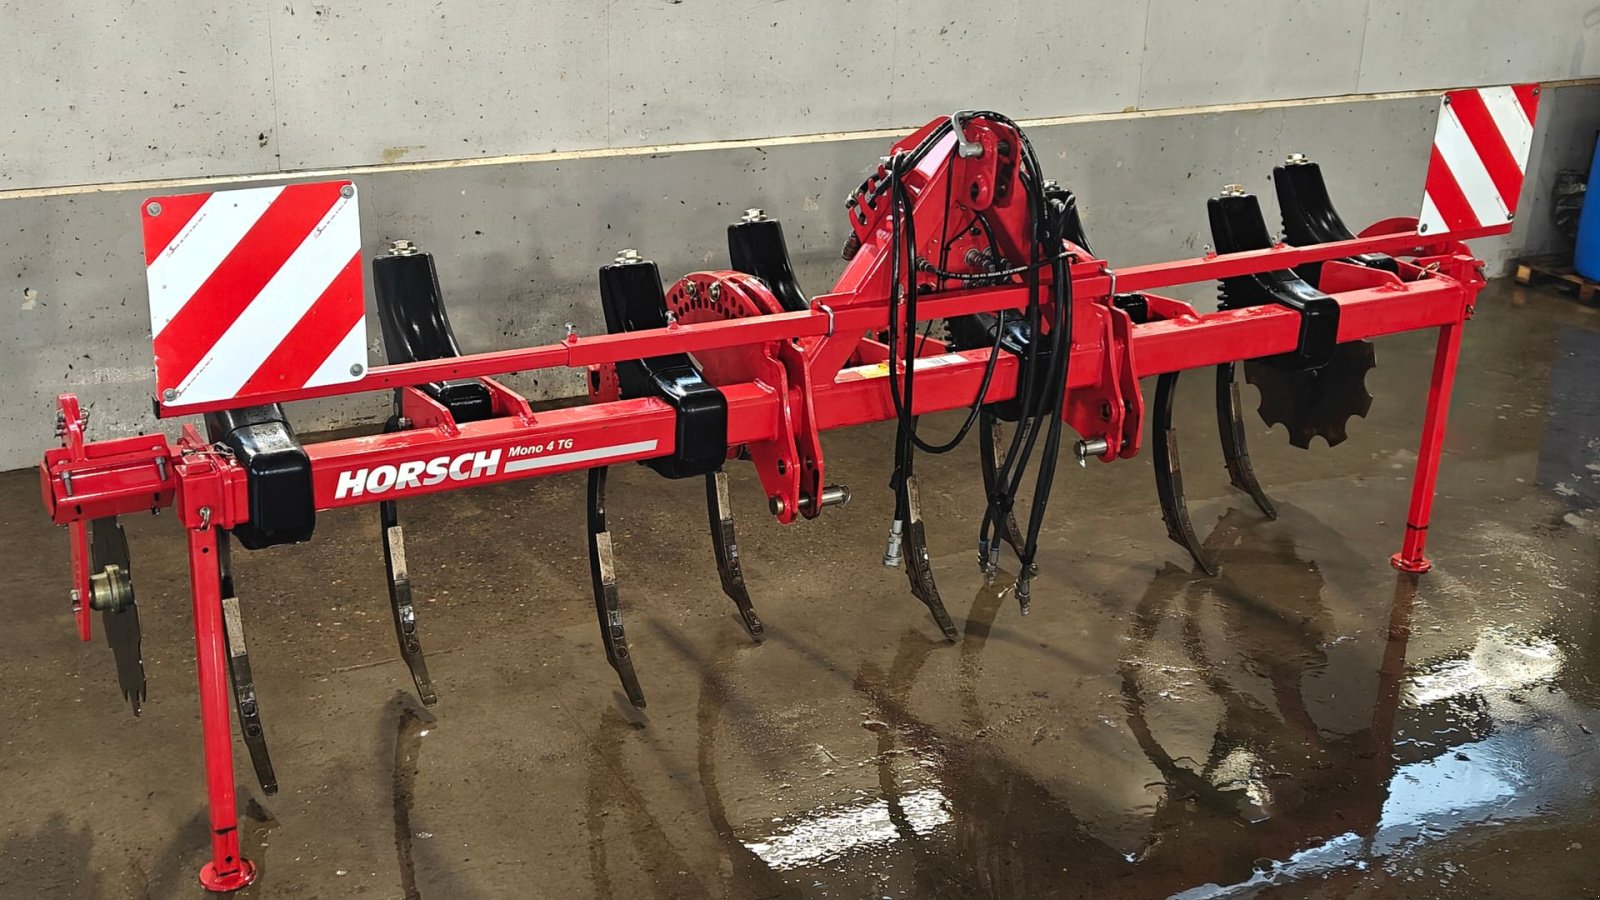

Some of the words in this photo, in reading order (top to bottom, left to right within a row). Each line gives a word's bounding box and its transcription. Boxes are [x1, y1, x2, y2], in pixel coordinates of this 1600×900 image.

[508, 445, 544, 457] Mono
[546, 440, 555, 451] 4
[558, 439, 574, 450] TG
[334, 448, 502, 499] HORSCH
